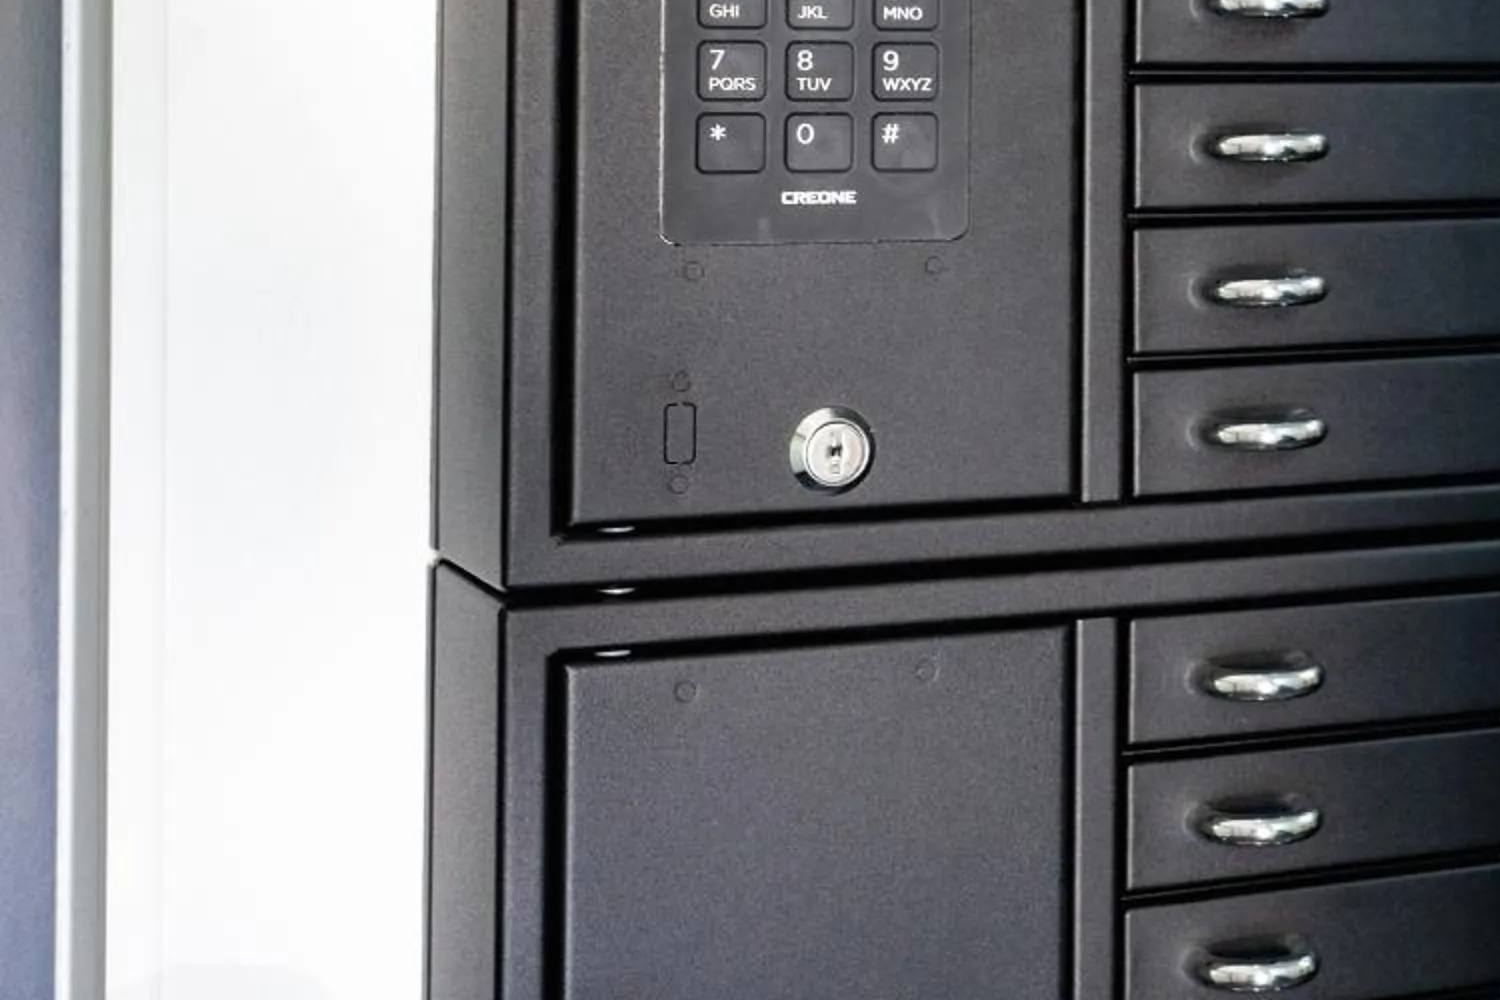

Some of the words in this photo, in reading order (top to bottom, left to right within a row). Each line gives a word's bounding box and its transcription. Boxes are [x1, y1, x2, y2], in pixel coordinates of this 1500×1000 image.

[709, 3, 739, 19] GHI
[797, 5, 827, 20] JKL
[883, 6, 923, 21] MNO
[709, 49, 725, 71] 7
[797, 50, 813, 72] 8
[882, 50, 899, 72] 9
[708, 77, 757, 93] PQRS
[796, 77, 832, 92] TUV
[882, 77, 932, 92] WXYZ
[796, 123, 815, 145] 0
